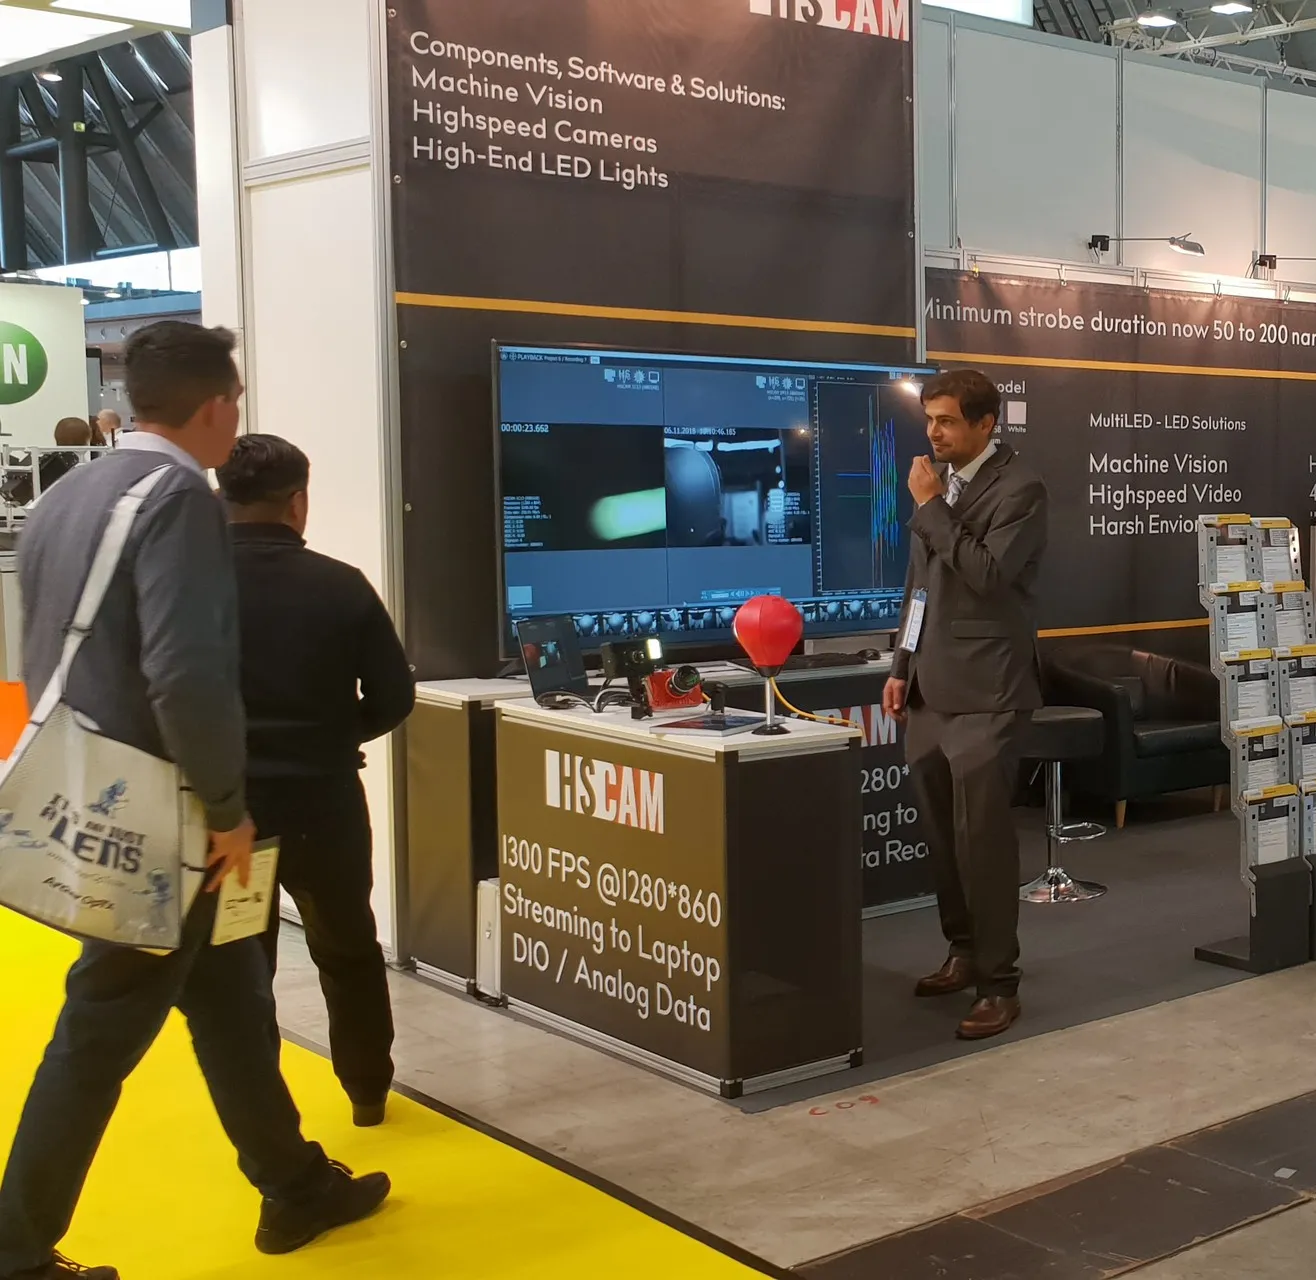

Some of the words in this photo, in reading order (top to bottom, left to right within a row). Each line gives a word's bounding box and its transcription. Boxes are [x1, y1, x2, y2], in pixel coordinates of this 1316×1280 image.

[410, 31, 563, 80] Components,
[568, 56, 666, 94] Software
[671, 74, 686, 96] &
[690, 78, 787, 111] Solutions:
[411, 65, 519, 104] Machine
[526, 84, 604, 114] Vision
[413, 100, 547, 140] Highspeed
[554, 121, 658, 154] Cameras
[413, 136, 533, 172] High-End
[541, 152, 592, 179] LED
[599, 160, 669, 190] Lights
[1018, 306, 1085, 331] strobe
[1090, 311, 1167, 336] duration
[1172, 324, 1210, 340] now
[1213, 320, 1234, 341] 50
[1238, 322, 1255, 342] to
[1259, 323, 1288, 344] 200
[997, 380, 1026, 394] odel
[1007, 425, 1026, 433] White
[1089, 412, 1153, 430] MultiLED
[1165, 415, 1190, 431] LED
[1192, 415, 1247, 432] Solutions
[1089, 452, 1169, 473] Machine
[1174, 453, 1228, 473] Vision
[1089, 483, 1187, 511] Highspeed
[1192, 483, 1242, 503] Video
[1090, 514, 1144, 535] Harsh
[863, 810, 891, 837] ng
[895, 802, 918, 825] to
[502, 833, 543, 875] 1300
[547, 847, 591, 890] FPS
[885, 839, 929, 865] Rec
[504, 882, 604, 956] Streaming
[610, 918, 632, 954] to
[638, 924, 721, 992] Laptop
[512, 932, 550, 973] DIO
[555, 948, 569, 984] /
[574, 955, 649, 1020] Analog
[656, 981, 711, 1032] Data
